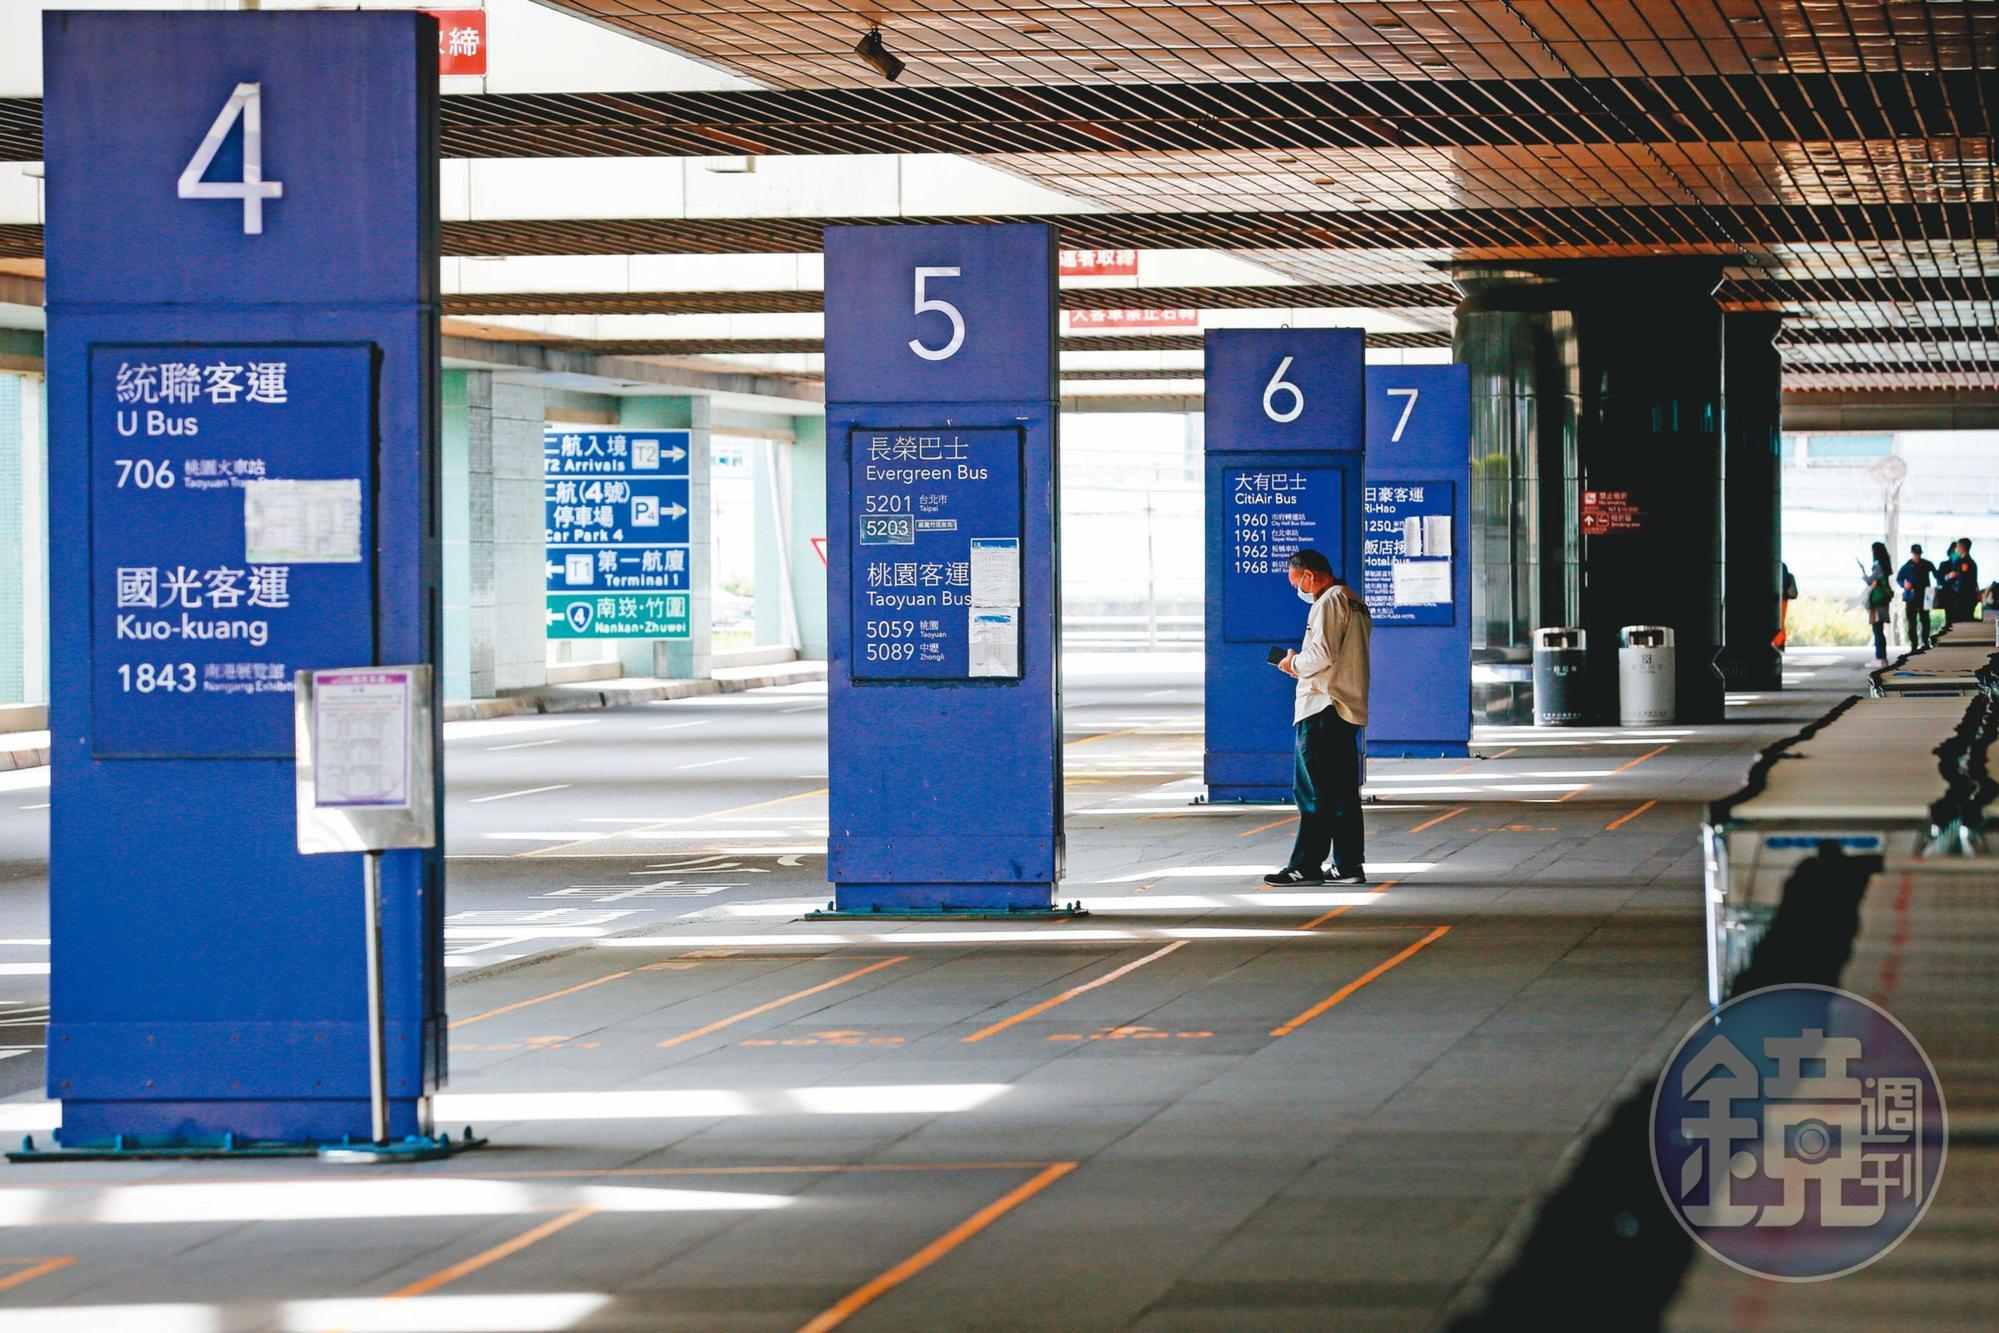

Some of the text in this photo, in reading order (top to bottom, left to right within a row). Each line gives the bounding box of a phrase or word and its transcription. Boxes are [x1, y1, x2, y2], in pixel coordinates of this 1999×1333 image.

[177, 82, 284, 236] 4
[908, 266, 966, 362] 5
[116, 361, 288, 405] 統聯客運
[1262, 356, 1305, 423] 6
[117, 410, 199, 437] U Bus
[1386, 388, 1419, 442] 7
[867, 436, 969, 461] 長榮巴士
[114, 458, 175, 489] 706
[564, 459, 625, 472] Arrivals
[866, 465, 988, 484] Evergreen Bus
[1235, 473, 1307, 491] 大有巴士
[919, 494, 947, 504] 台北市
[1234, 492, 1297, 505] CitiAir Bus
[1365, 487, 1424, 502] 日豪客運
[865, 495, 912, 513] 5201
[1365, 503, 1396, 513] Ri-Hao
[553, 505, 614, 528] 停車場
[1234, 513, 1268, 527] 1960
[866, 520, 909, 536] 5203
[1365, 520, 1391, 532] 1250
[545, 529, 624, 542] Car Park 4
[1234, 529, 1267, 542] 1961
[597, 549, 685, 572] 第一航廈
[1234, 545, 1268, 558] 1962
[867, 562, 969, 587] 桃園客運
[1234, 560, 1268, 574] 1968
[116, 566, 290, 608] 國光客運
[604, 573, 679, 587] Terminal 1
[867, 592, 971, 610] Taoyuan Bus
[573, 607, 586, 626] 4
[920, 620, 939, 630] 桃園
[116, 613, 268, 646] Kuo-kuang
[866, 621, 914, 638] 5059
[866, 643, 914, 661] 5089
[920, 653, 944, 661] Zhongli
[117, 662, 197, 693] 1843
